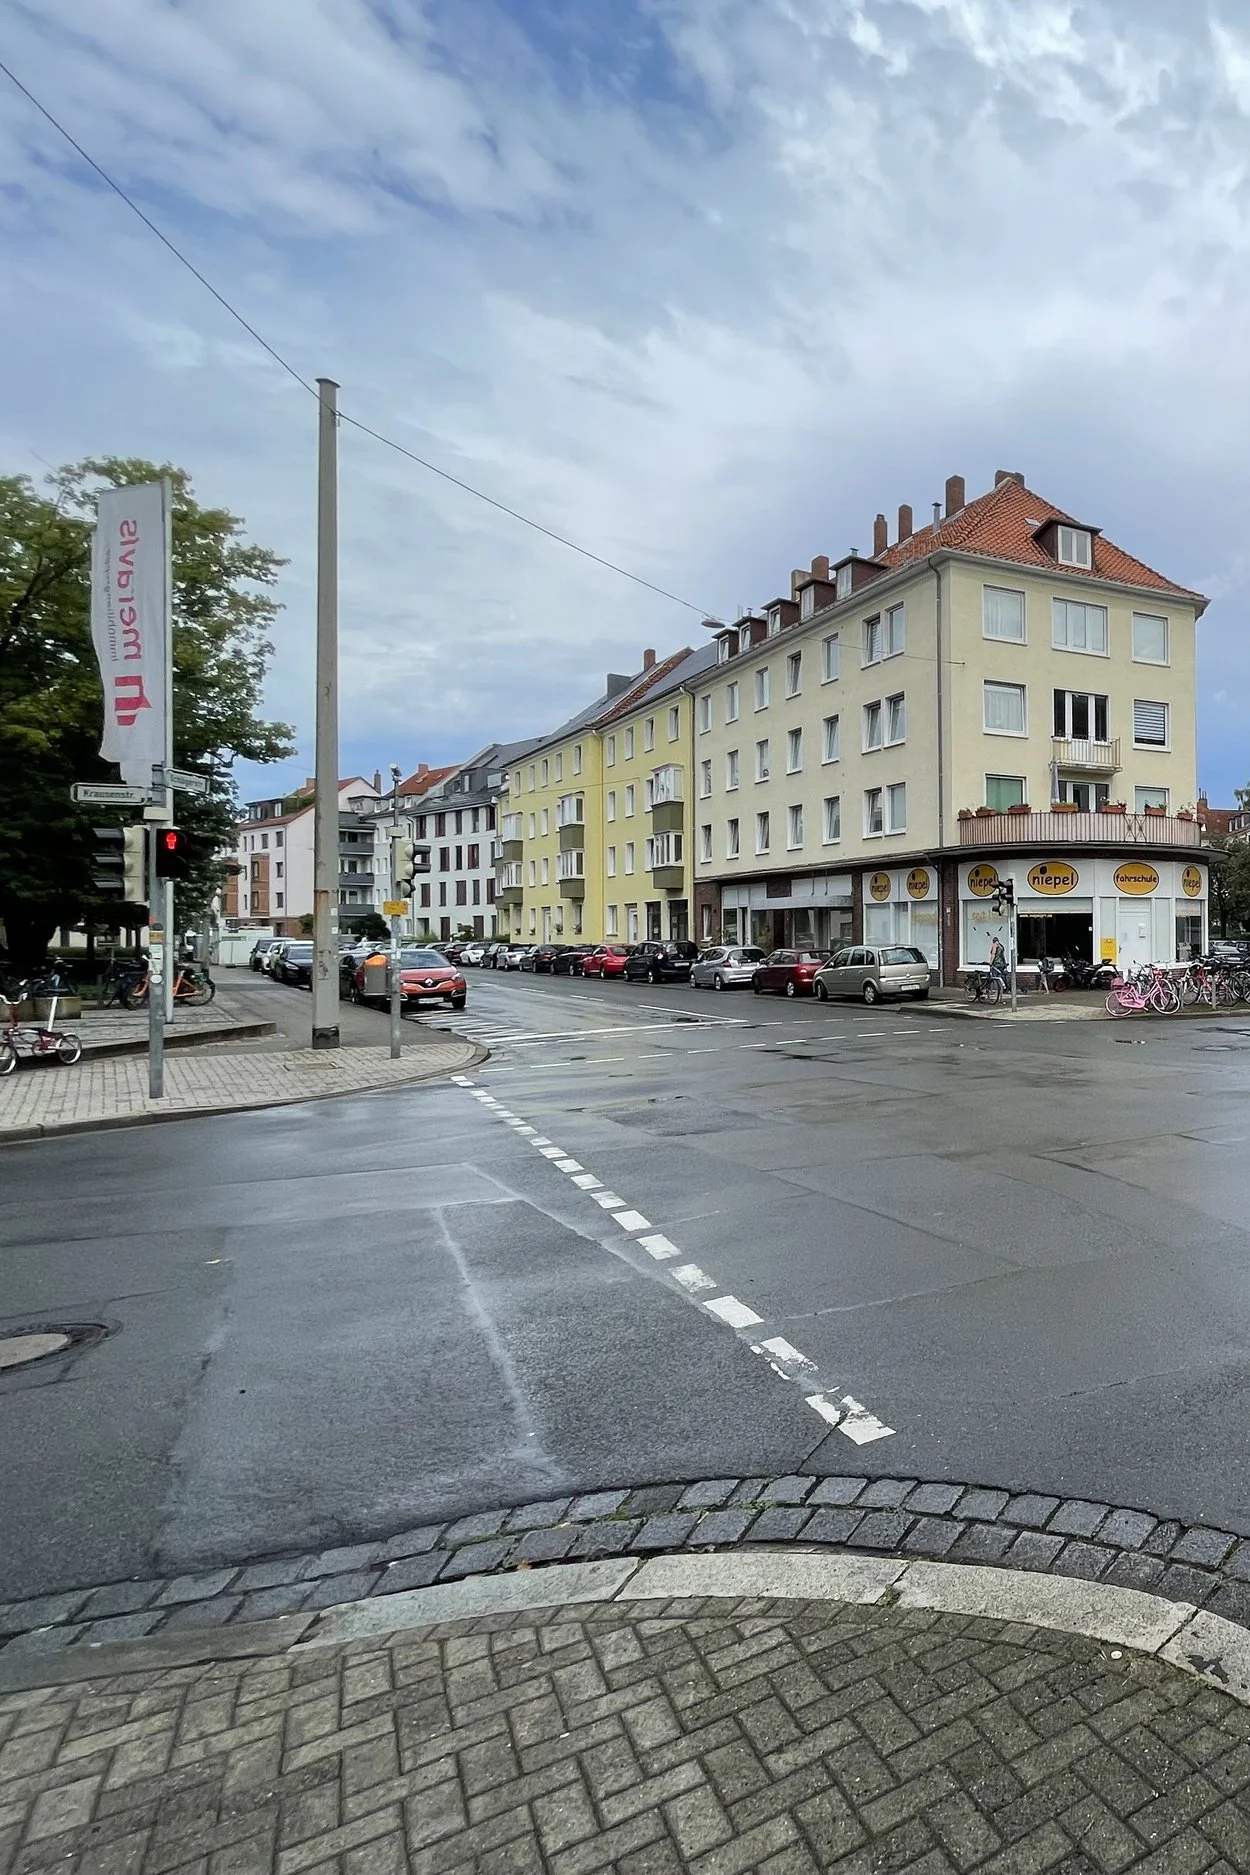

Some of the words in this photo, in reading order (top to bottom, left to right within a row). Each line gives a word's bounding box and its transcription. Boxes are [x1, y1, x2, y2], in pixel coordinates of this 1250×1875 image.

[83, 789, 136, 799] Krausenstr.
[1032, 873, 1074, 889] niepel
[1115, 874, 1157, 883] fahrschule
[908, 878, 928, 893] niepel
